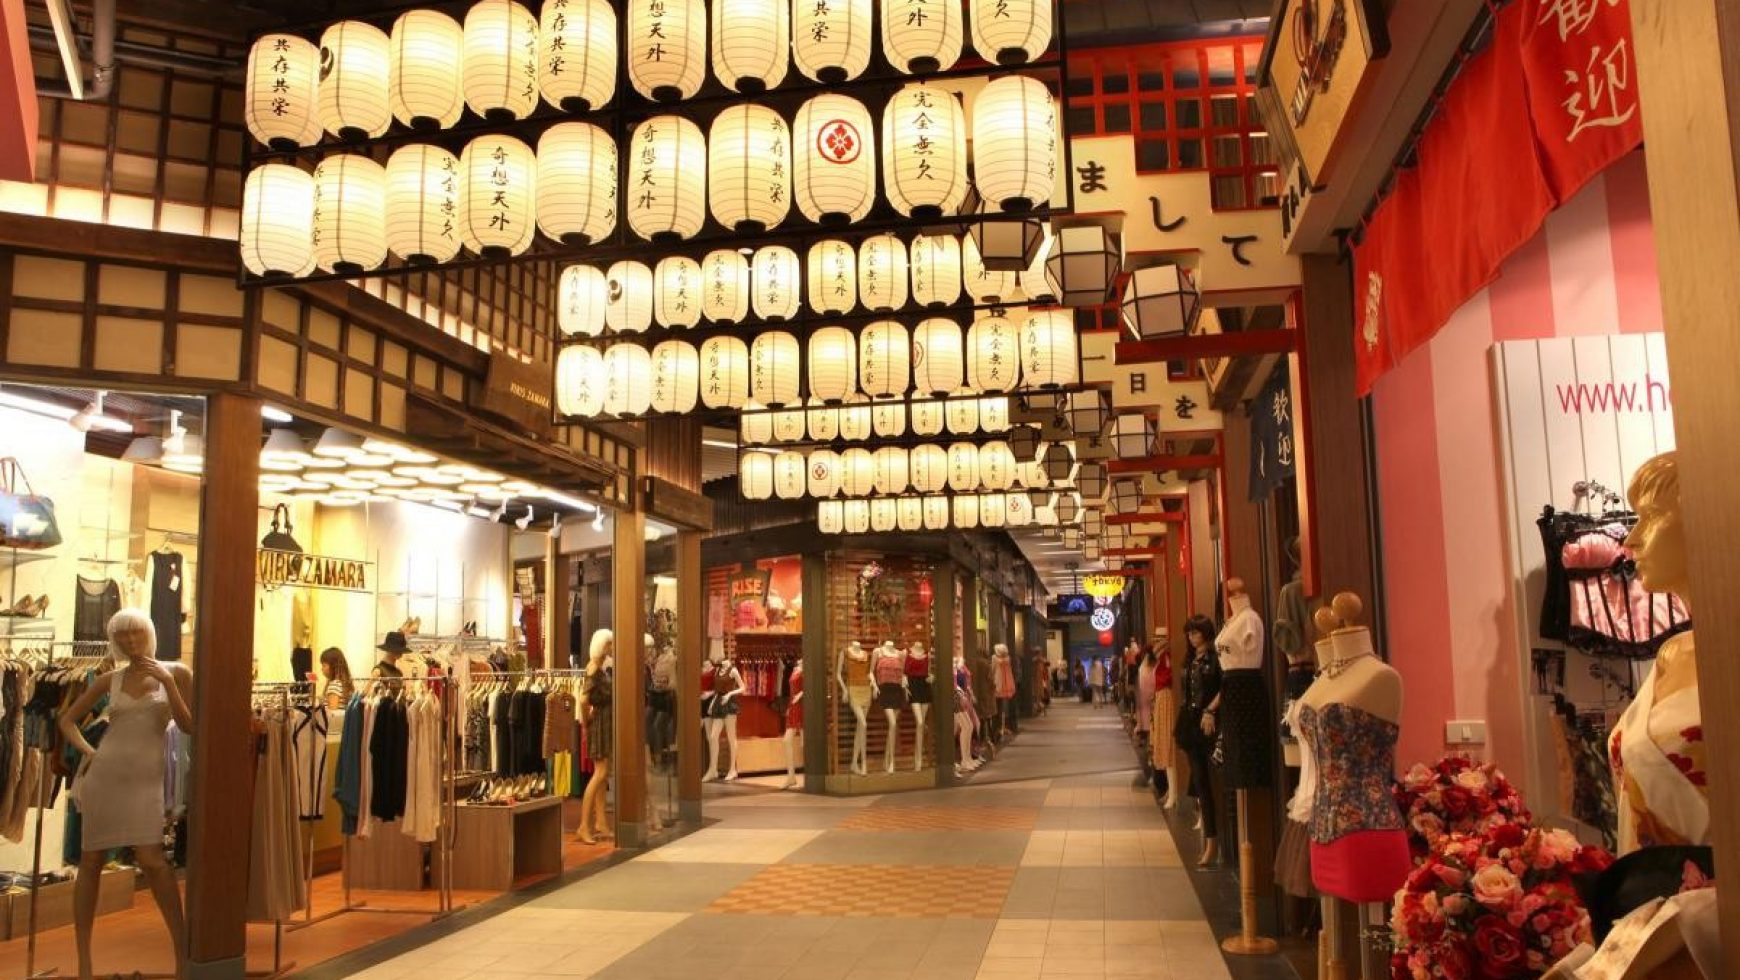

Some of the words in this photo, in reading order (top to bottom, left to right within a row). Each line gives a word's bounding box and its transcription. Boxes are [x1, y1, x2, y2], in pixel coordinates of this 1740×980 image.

[1556, 373, 1671, 414] www.h
[259, 549, 302, 583] VIRIS
[304, 556, 365, 589] ZAMARA
